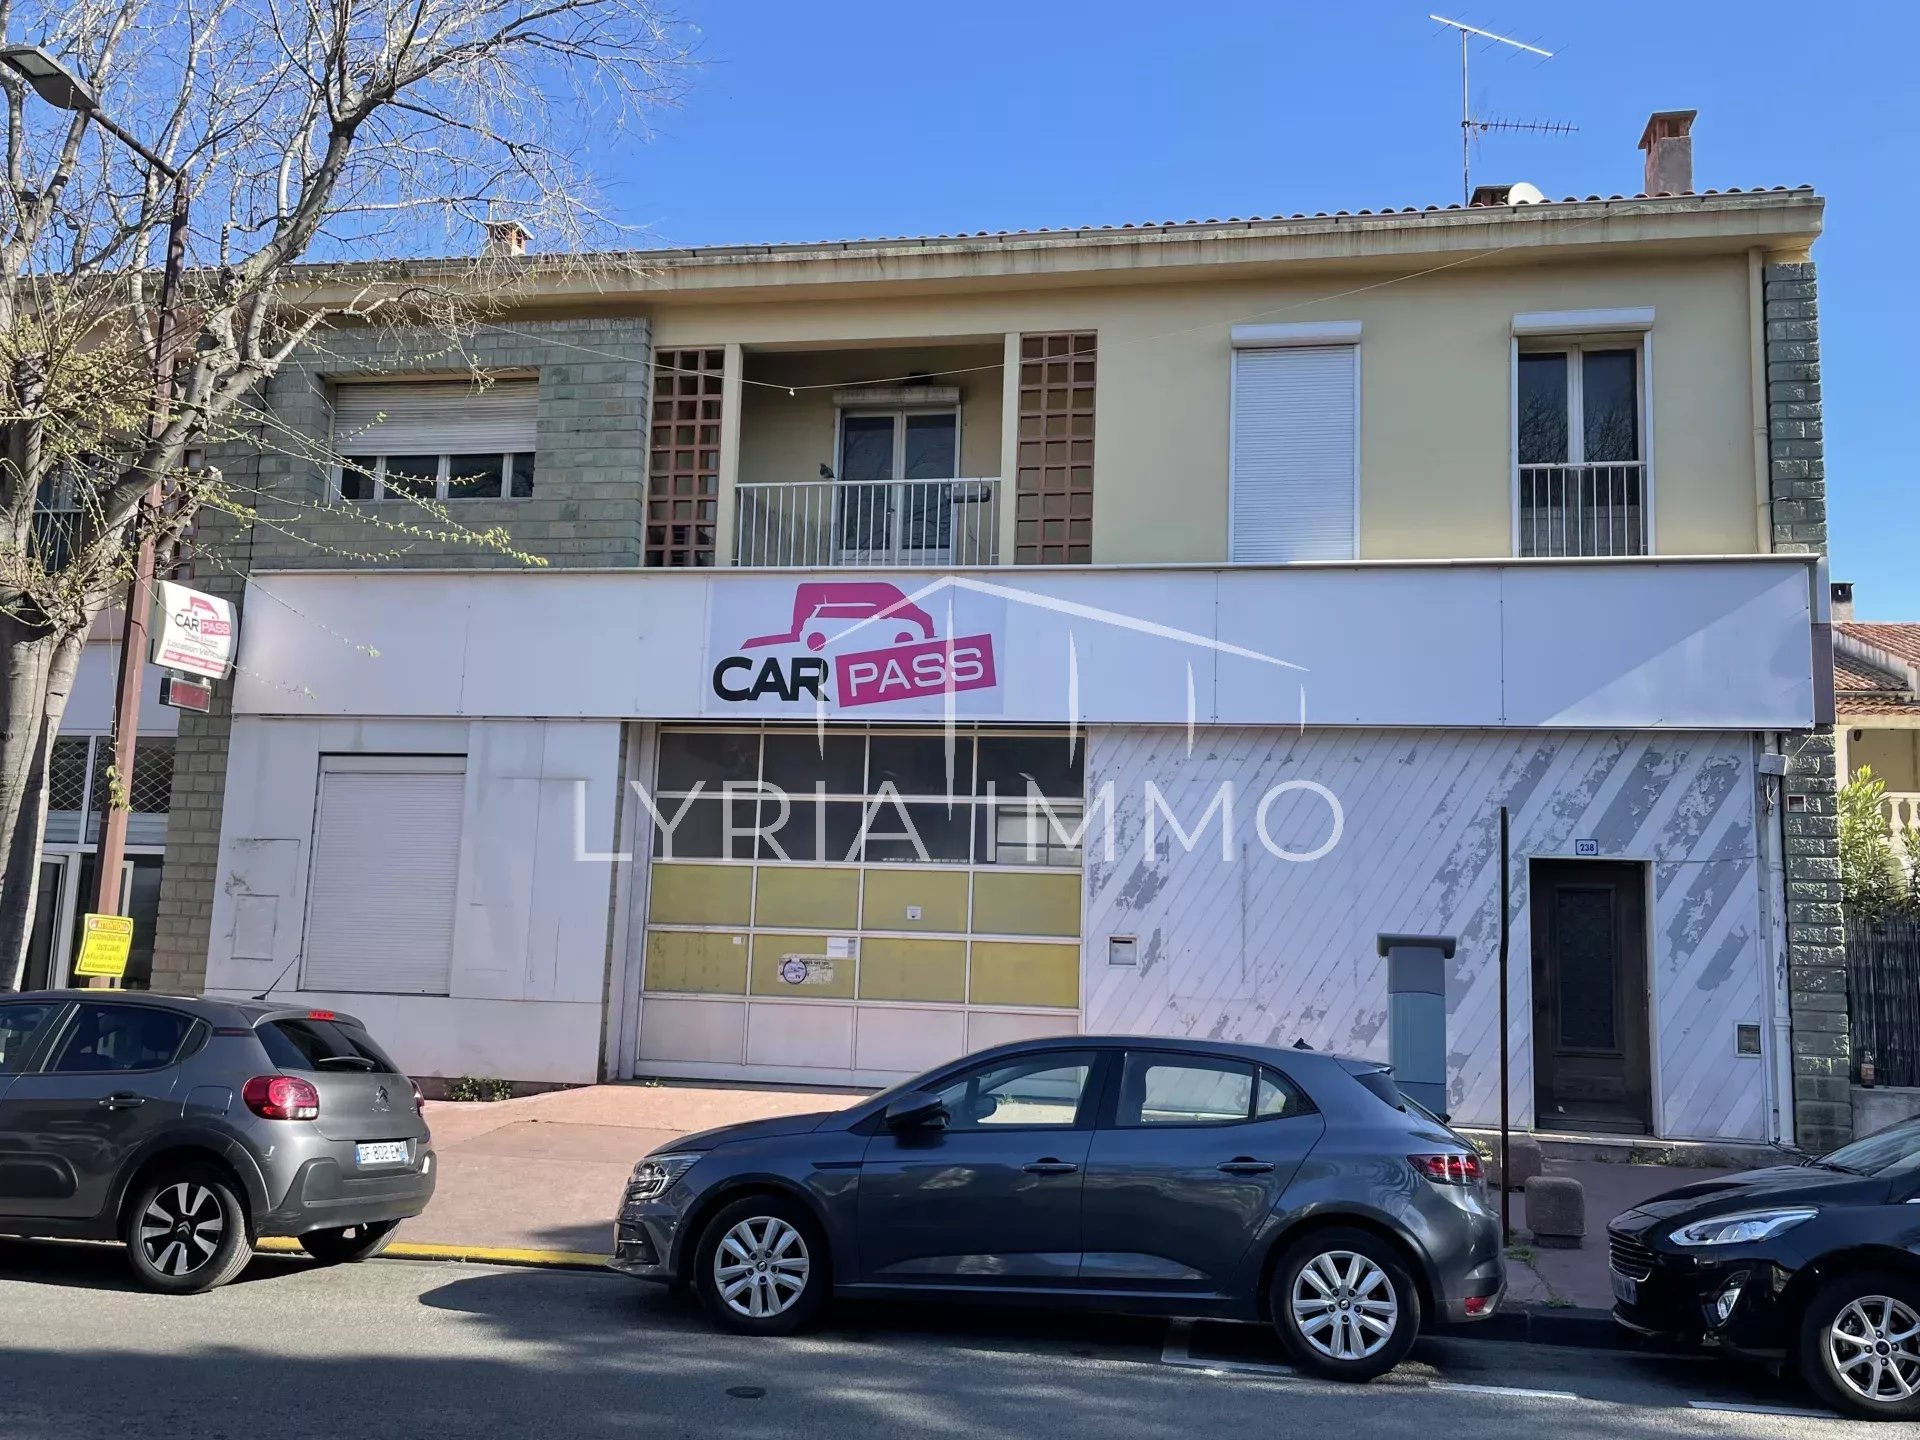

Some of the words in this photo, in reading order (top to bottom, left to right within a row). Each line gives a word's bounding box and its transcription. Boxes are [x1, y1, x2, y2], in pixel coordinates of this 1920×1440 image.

[175, 613, 199, 632] CAR
[202, 621, 230, 634] PASS
[712, 656, 830, 701] CAR
[849, 647, 984, 697] PASS
[1580, 843, 1595, 852] 238
